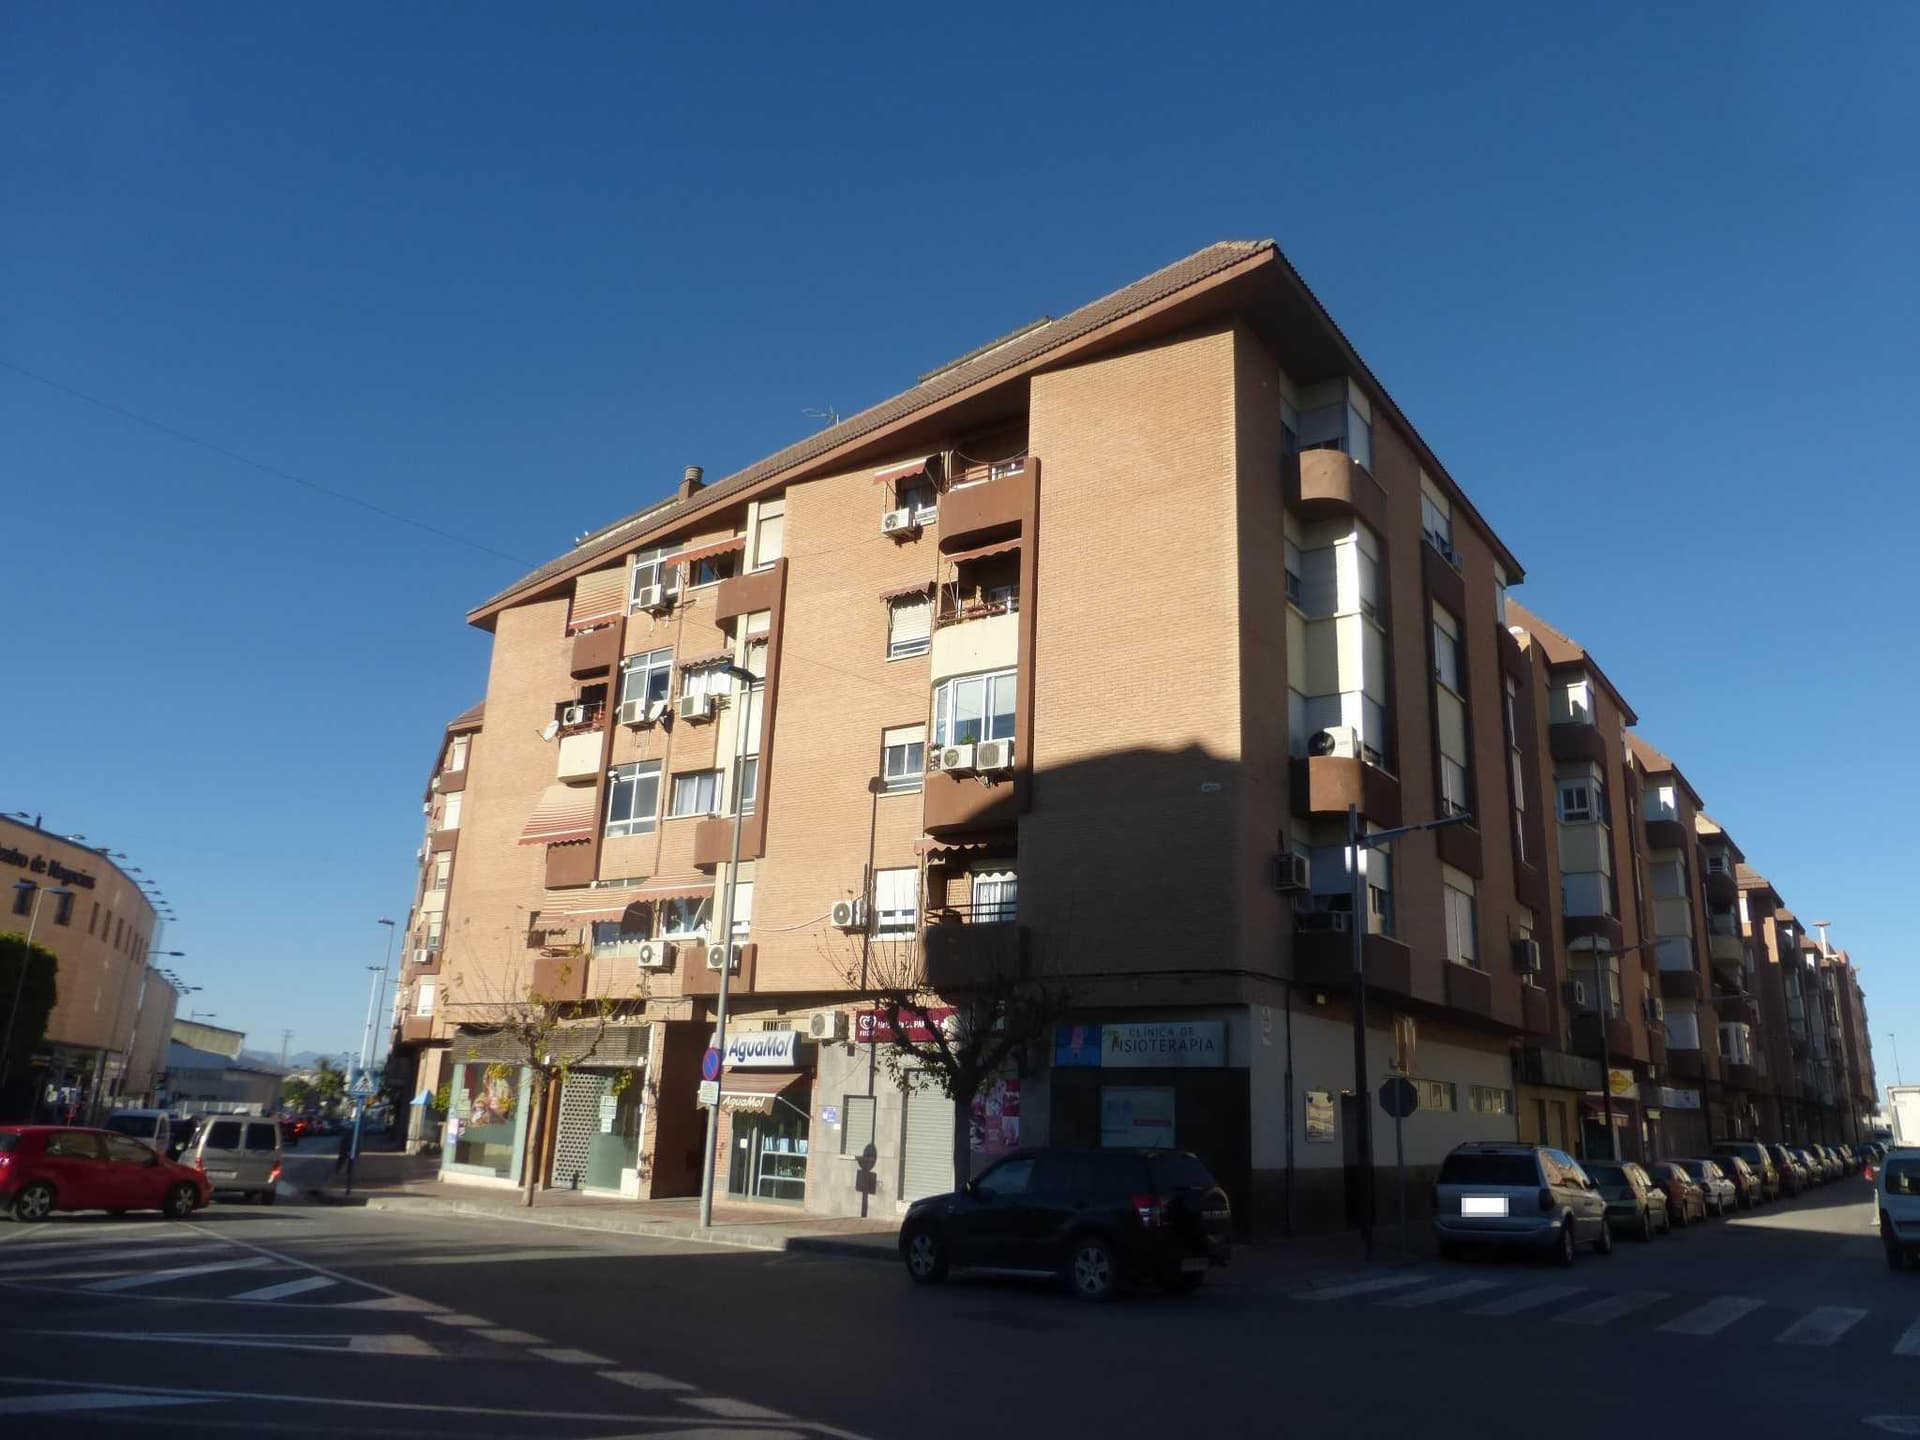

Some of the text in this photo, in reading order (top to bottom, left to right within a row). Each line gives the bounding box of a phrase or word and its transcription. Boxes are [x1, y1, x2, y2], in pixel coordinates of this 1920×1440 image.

[1182, 1025, 1195, 1037] DE
[729, 1034, 793, 1063] AguaMol
[1111, 1037, 1216, 1054] FISIOTERAPIA
[722, 1095, 766, 1108] AguaMol
